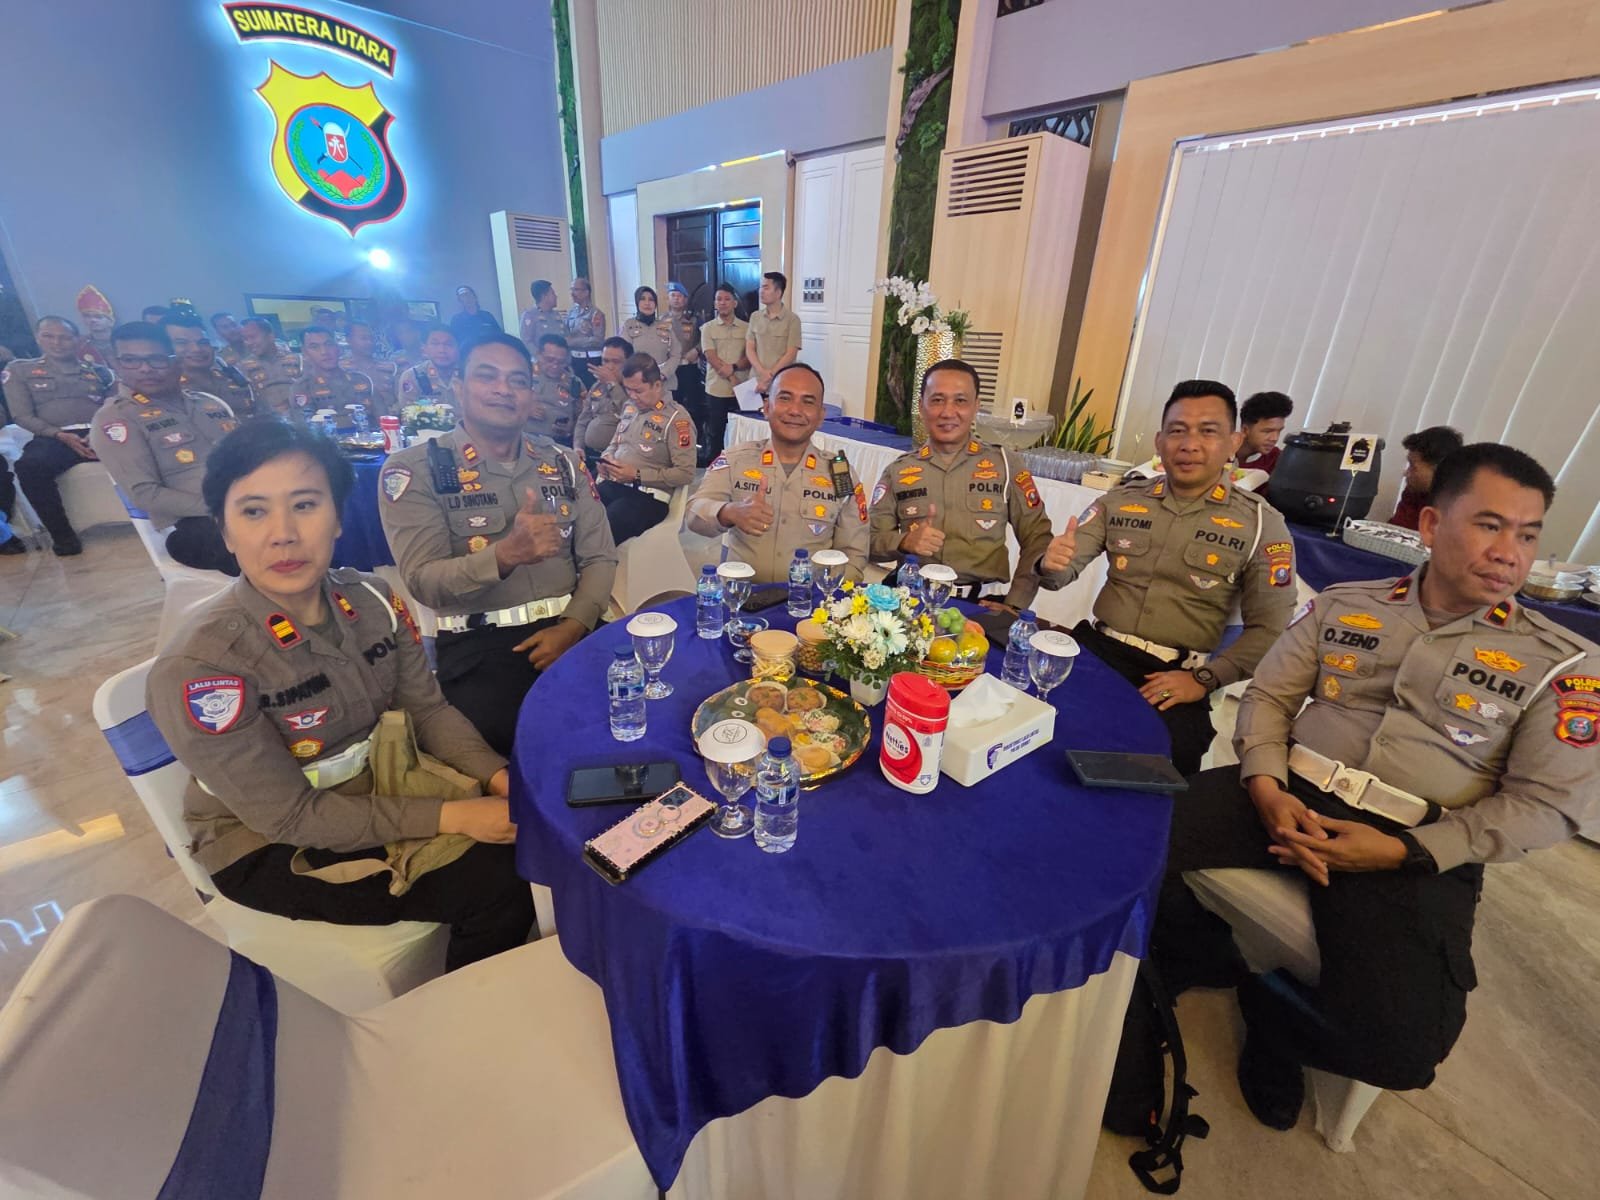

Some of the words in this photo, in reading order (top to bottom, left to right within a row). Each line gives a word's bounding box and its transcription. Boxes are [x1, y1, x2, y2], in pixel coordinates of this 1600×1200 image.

[232, 9, 333, 42] SUMATERA
[335, 25, 390, 67] UTARA
[803, 489, 837, 502] POLRI
[968, 482, 1002, 494] POLRI
[1194, 529, 1246, 551] POLRI
[363, 636, 398, 666] POL
[1323, 627, 1380, 651] O.ZEND
[1452, 662, 1526, 702] POLRI
